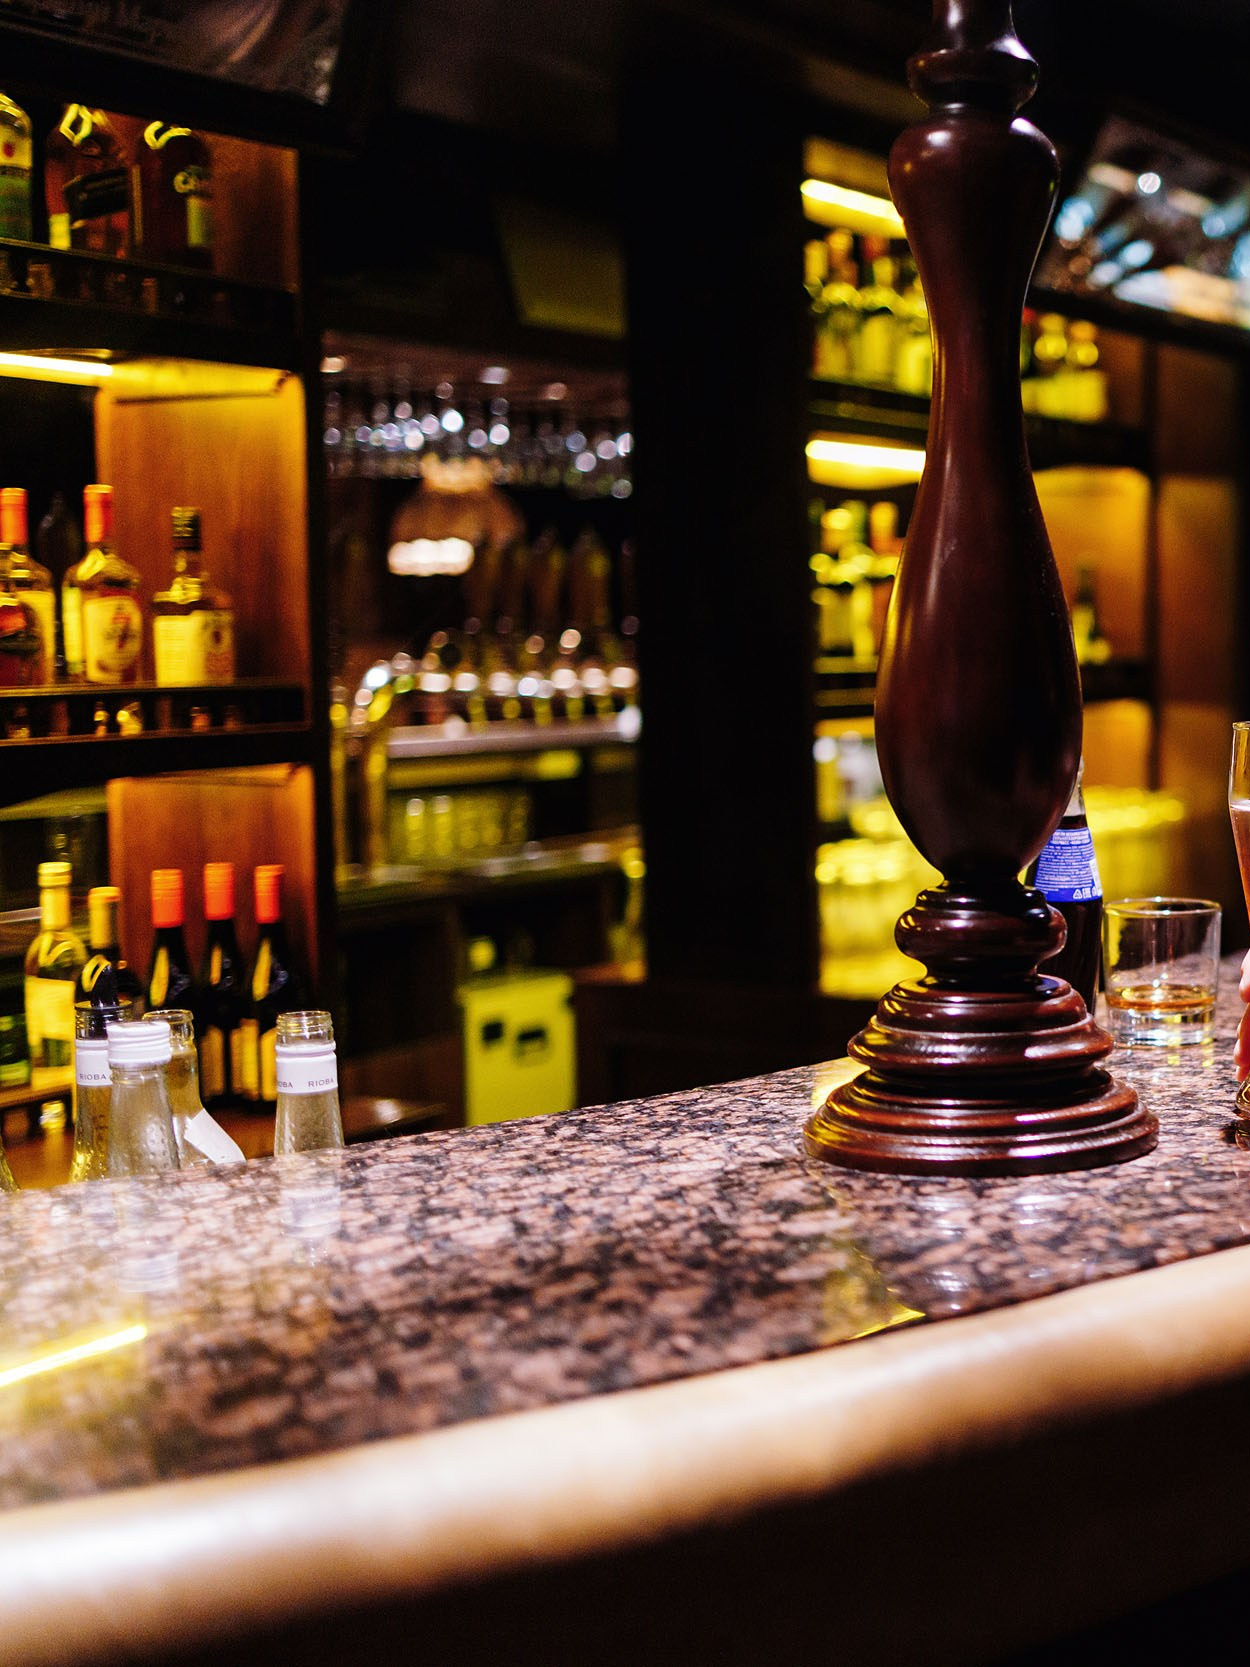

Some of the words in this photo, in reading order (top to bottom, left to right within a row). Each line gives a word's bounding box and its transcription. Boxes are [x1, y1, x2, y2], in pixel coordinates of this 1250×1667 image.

[79, 1073, 107, 1081] RIOBA
[278, 1081, 294, 1089] OBA
[308, 1077, 334, 1088] RIOBA
